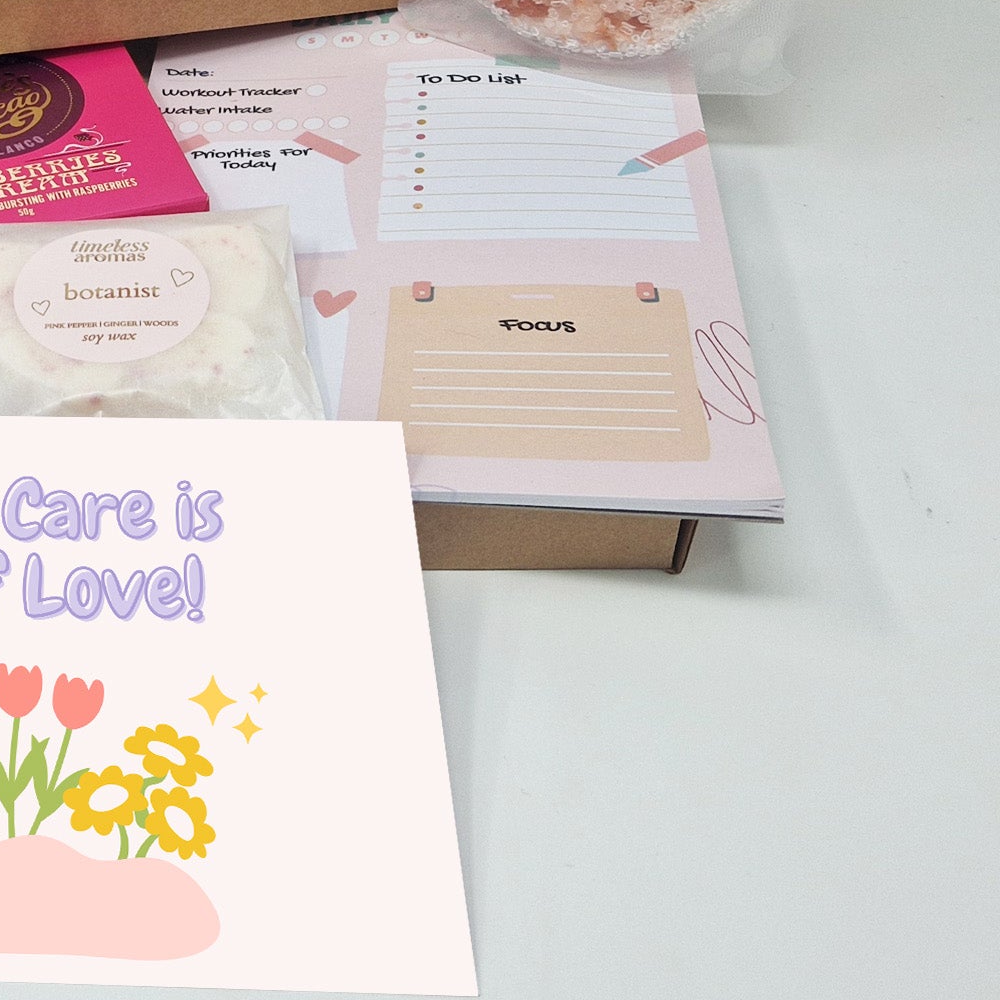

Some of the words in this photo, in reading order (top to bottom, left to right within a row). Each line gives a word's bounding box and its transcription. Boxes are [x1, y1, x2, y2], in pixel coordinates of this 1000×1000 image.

[165, 67, 214, 77] Date:
[416, 74, 443, 84] To
[446, 74, 482, 83] Do
[488, 73, 527, 85] List
[161, 87, 237, 98] Workout
[239, 86, 302, 97] Tracker
[218, 105, 273, 115] Intake
[191, 147, 271, 160] Priorities
[280, 147, 312, 157] For
[219, 159, 277, 172] Today
[46, 189, 72, 202] WITH
[73, 177, 138, 197] RASPBERRIES
[18, 208, 35, 217] 50g
[71, 239, 150, 253] timeless
[74, 252, 146, 263] aromas
[64, 282, 160, 301] botanist
[44, 322, 66, 330] PINK
[67, 321, 98, 329] PEPPER
[103, 320, 138, 328] GINGER
[143, 320, 179, 328] WOODS
[498, 319, 577, 333] Focus
[82, 332, 104, 345] soy
[108, 331, 137, 341] wax
[0, 475, 159, 542] Care
[175, 479, 225, 542] is
[22, 551, 206, 624] Love!
